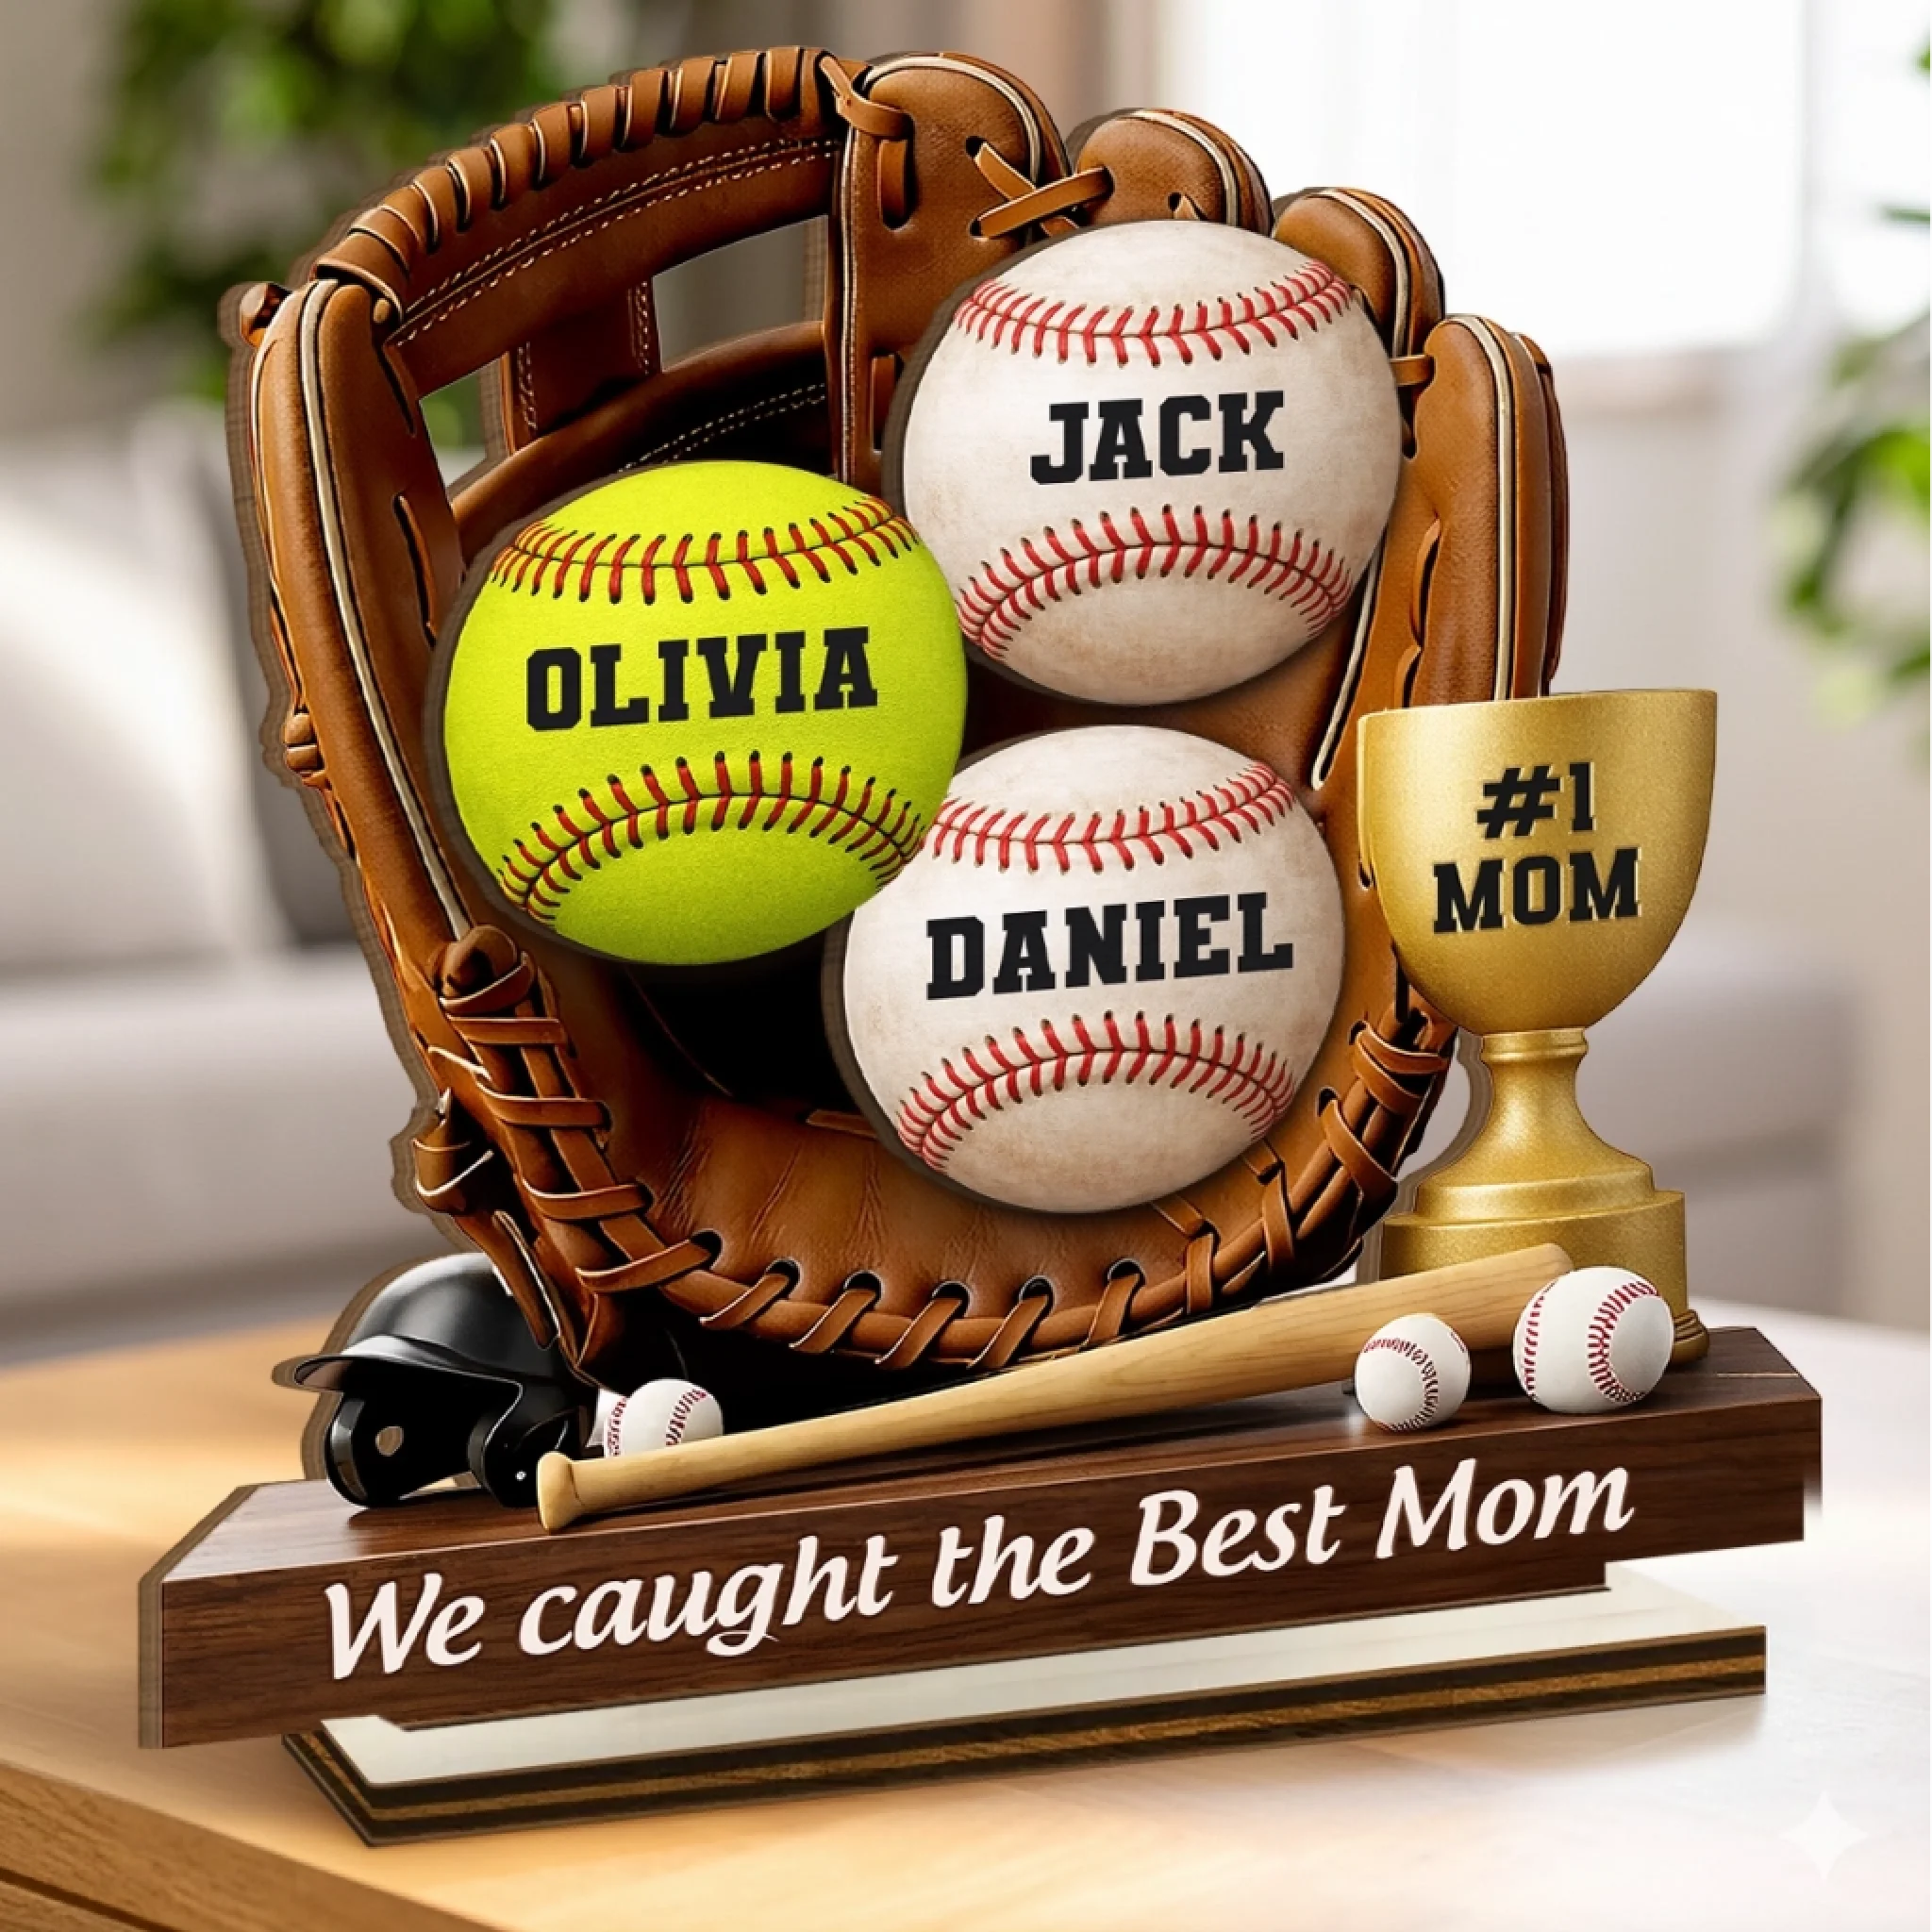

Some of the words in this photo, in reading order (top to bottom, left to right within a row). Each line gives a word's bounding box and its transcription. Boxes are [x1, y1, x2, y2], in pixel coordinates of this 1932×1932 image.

[1030, 390, 1285, 486] JACK
[526, 625, 879, 732] OLIVIA
[1475, 760, 1594, 841] #1
[1432, 845, 1640, 935] MOM
[926, 891, 1294, 1002] DANIEL
[324, 1572, 485, 1681] We
[519, 1534, 900, 1657] caught
[930, 1514, 1094, 1606] the
[1129, 1485, 1347, 1588] Best
[1375, 1457, 1636, 1559] Mom
